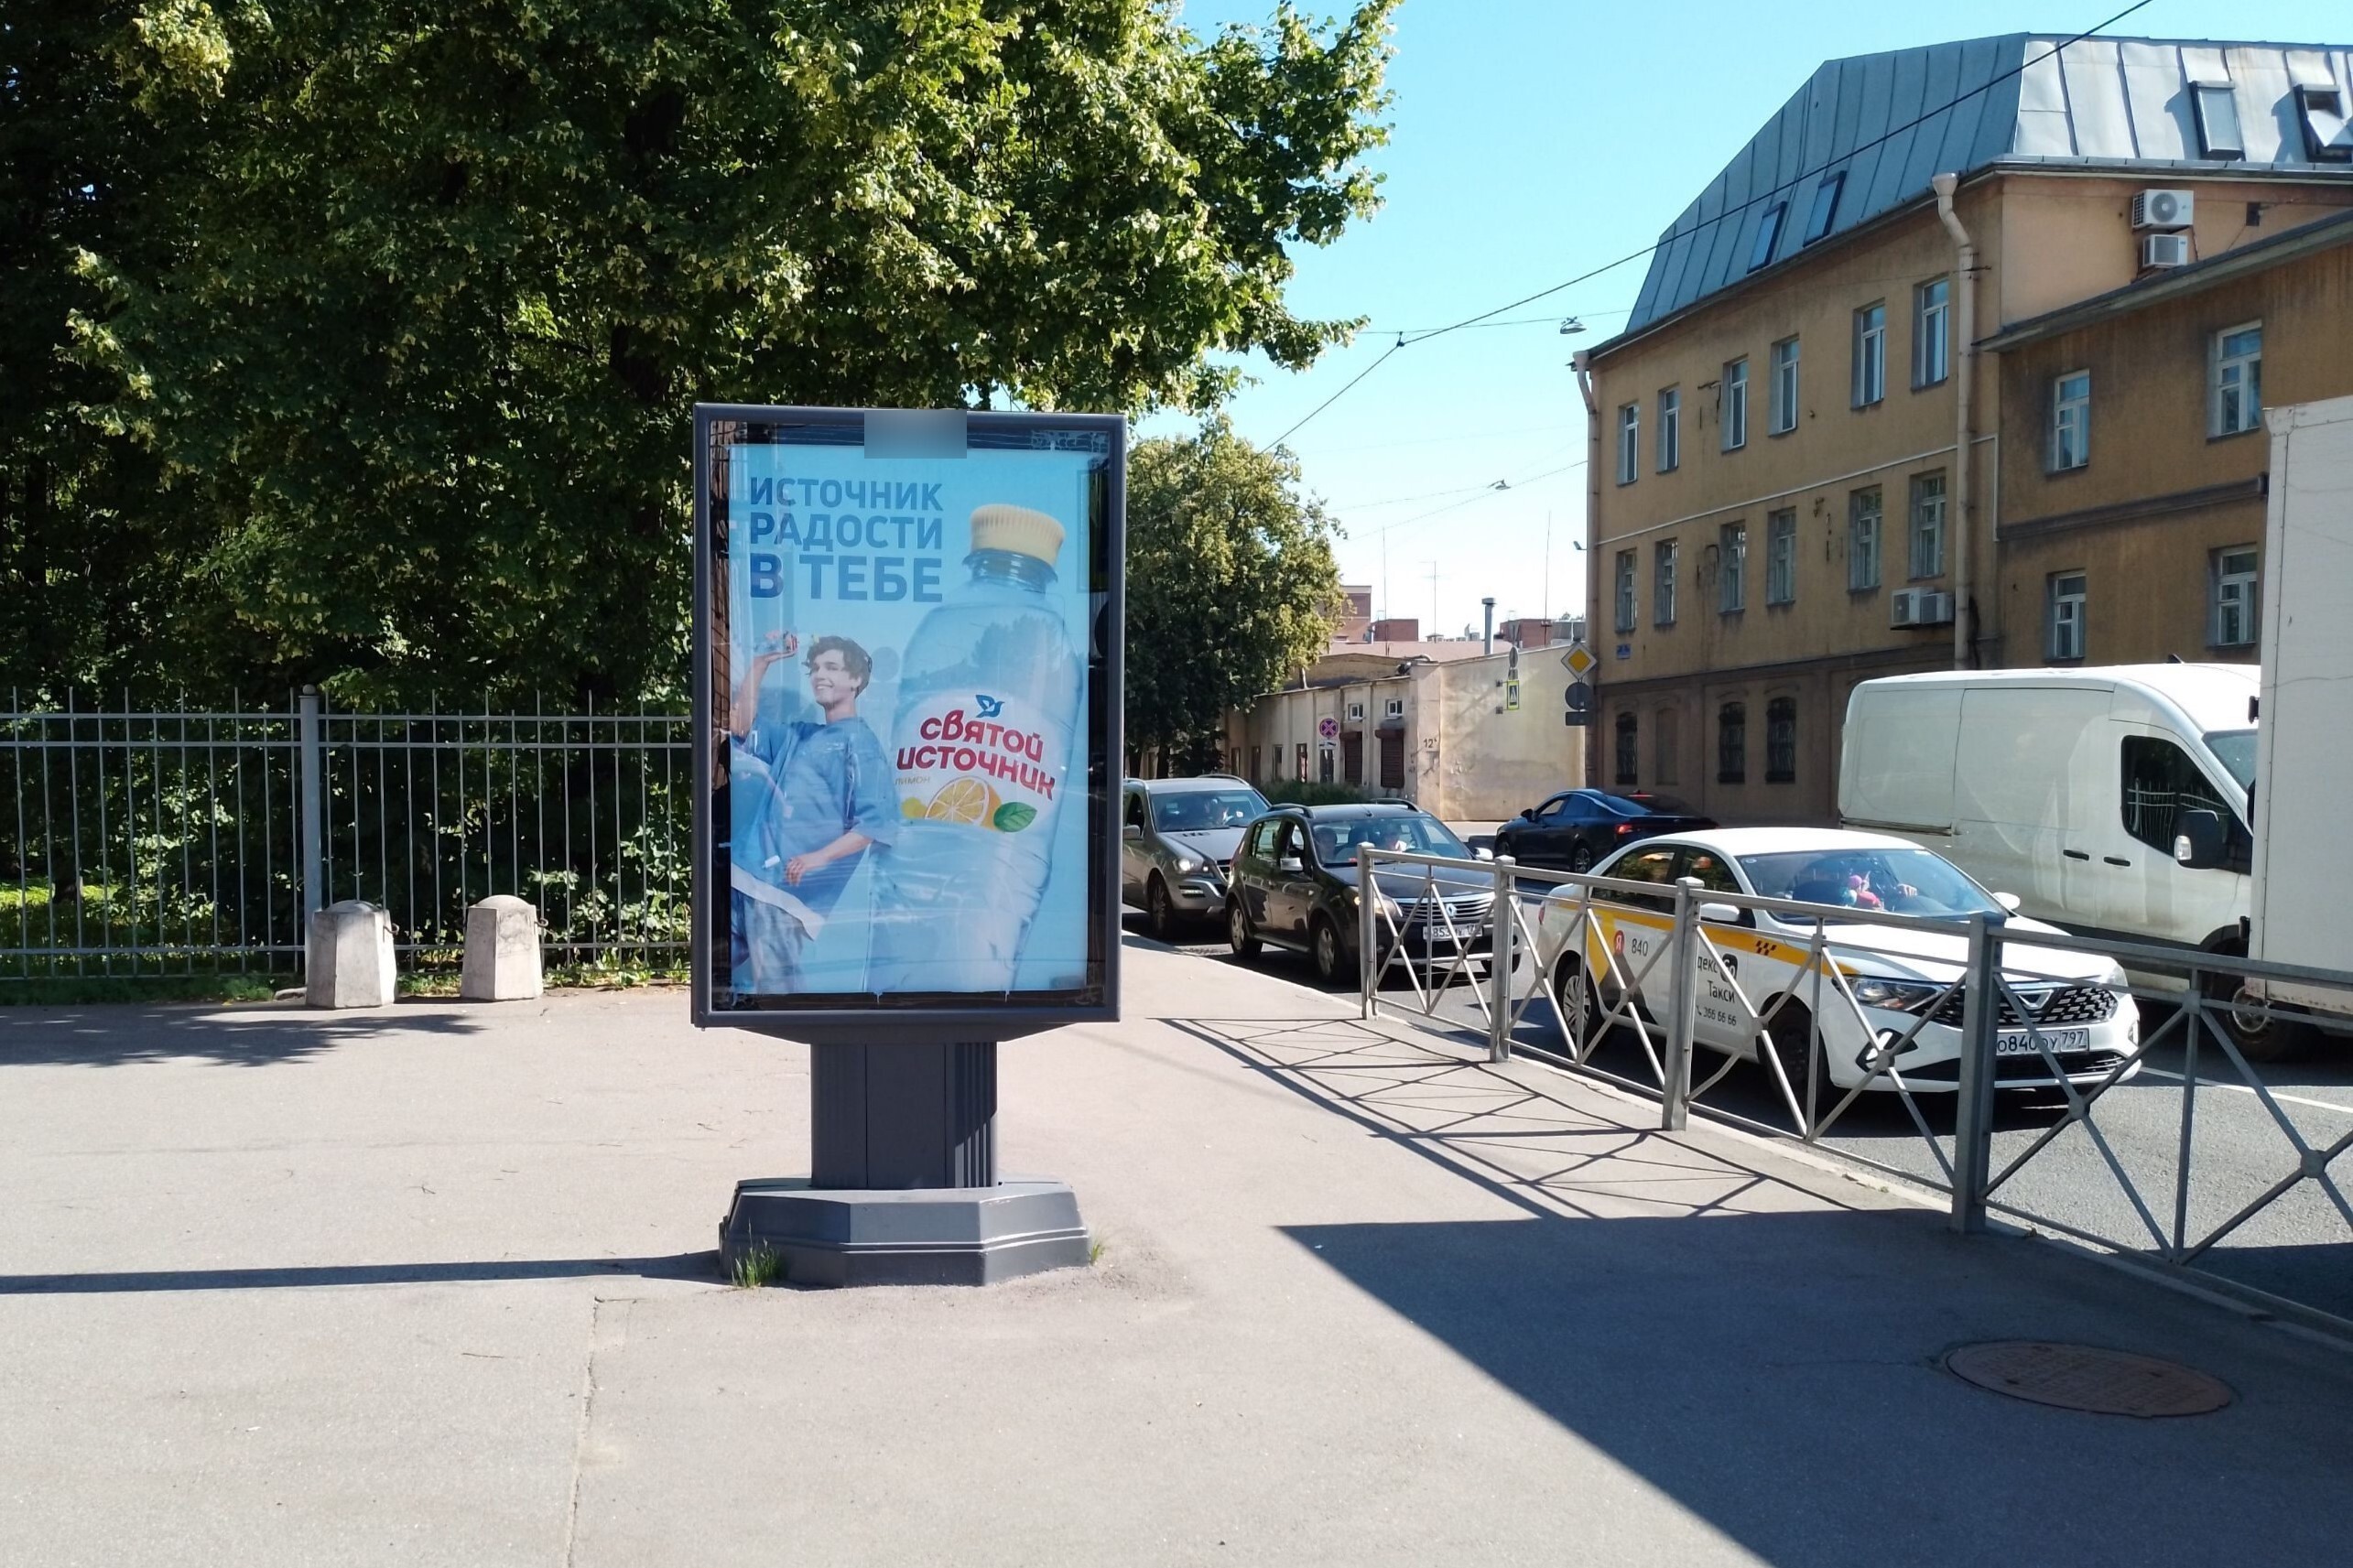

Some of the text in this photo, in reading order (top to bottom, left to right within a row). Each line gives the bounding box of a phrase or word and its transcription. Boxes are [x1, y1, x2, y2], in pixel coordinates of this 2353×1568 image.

[750, 476, 944, 512] ИСТОЧНИК
[750, 512, 943, 552] РАДОСТИ
[749, 552, 943, 603] В ТЕБЕ
[1631, 938, 1649, 957] 840
[1697, 956, 1719, 974] декс
[1707, 979, 1736, 1003] Такси
[2062, 1031, 2085, 1047] 797
